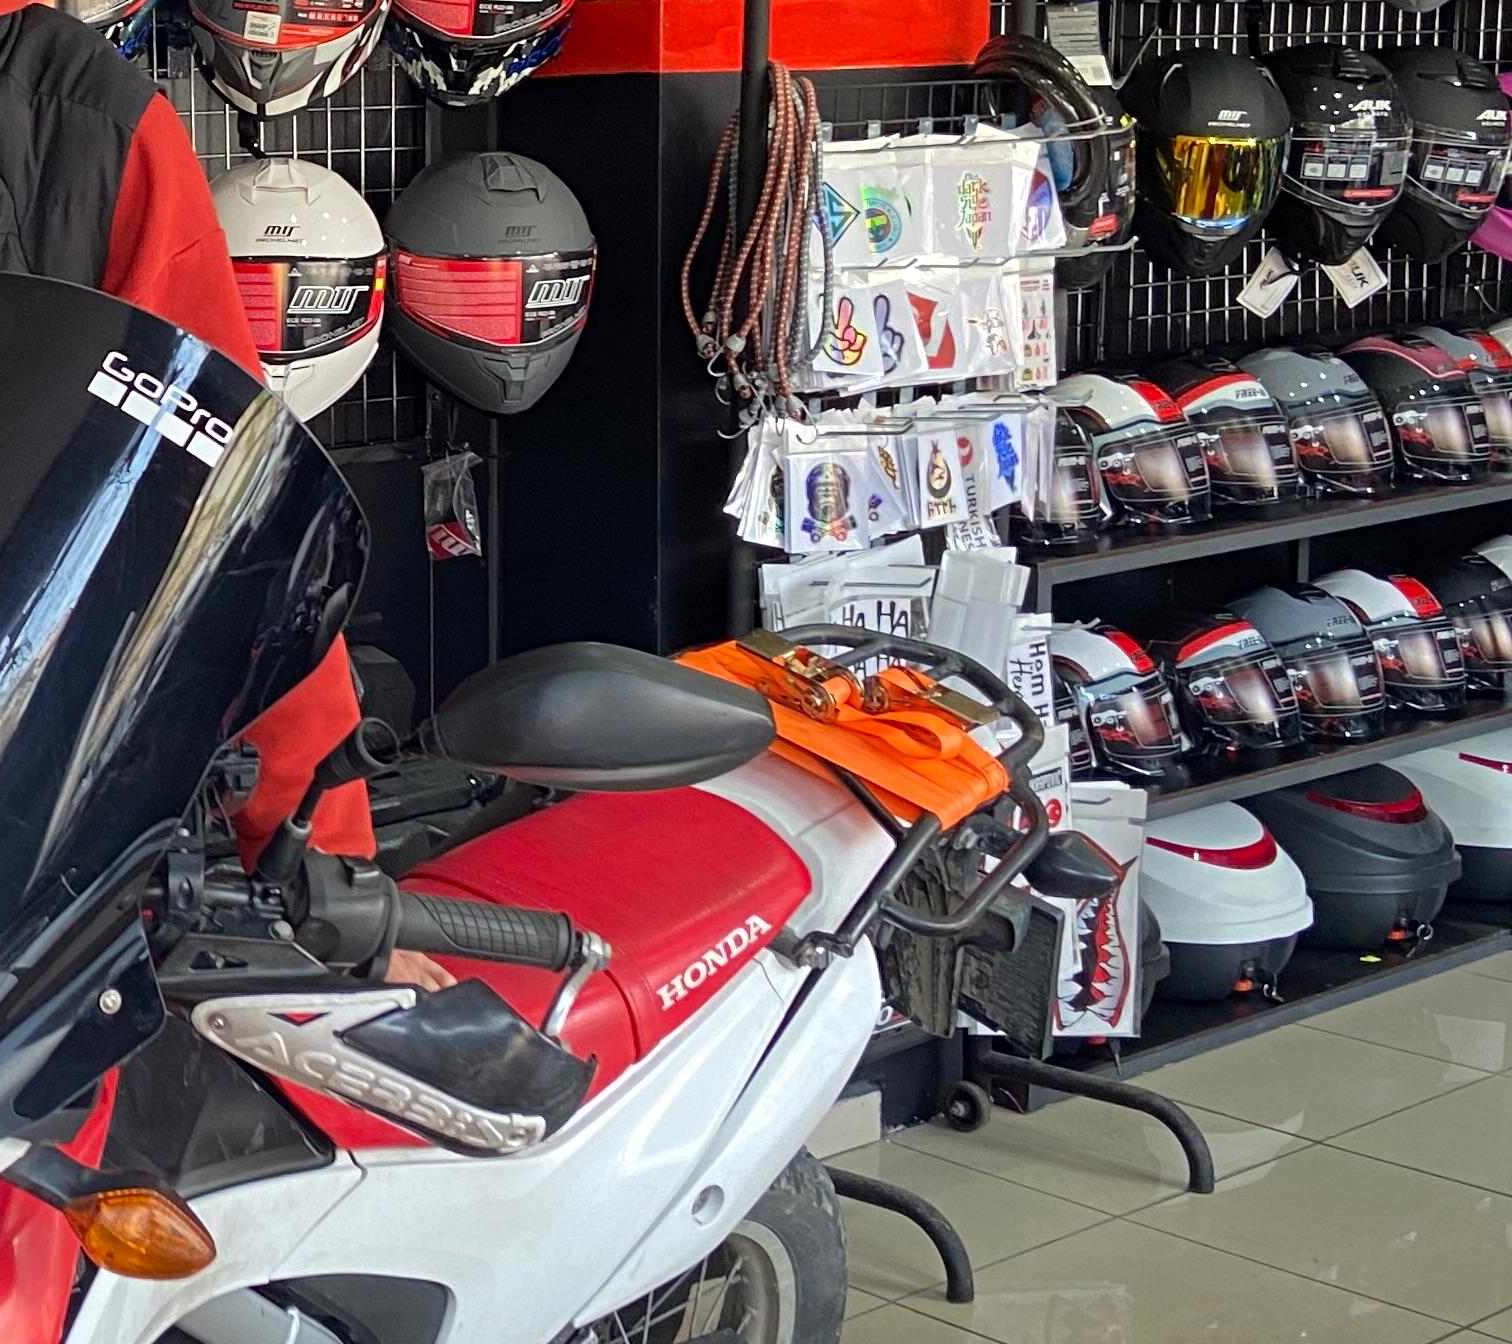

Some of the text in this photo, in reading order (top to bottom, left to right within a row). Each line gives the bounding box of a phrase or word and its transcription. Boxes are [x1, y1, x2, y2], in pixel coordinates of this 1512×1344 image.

[102, 351, 233, 444] GoPro
[966, 474, 987, 548] TURKISH
[877, 600, 909, 637] HA
[658, 912, 772, 1011] HONDA
